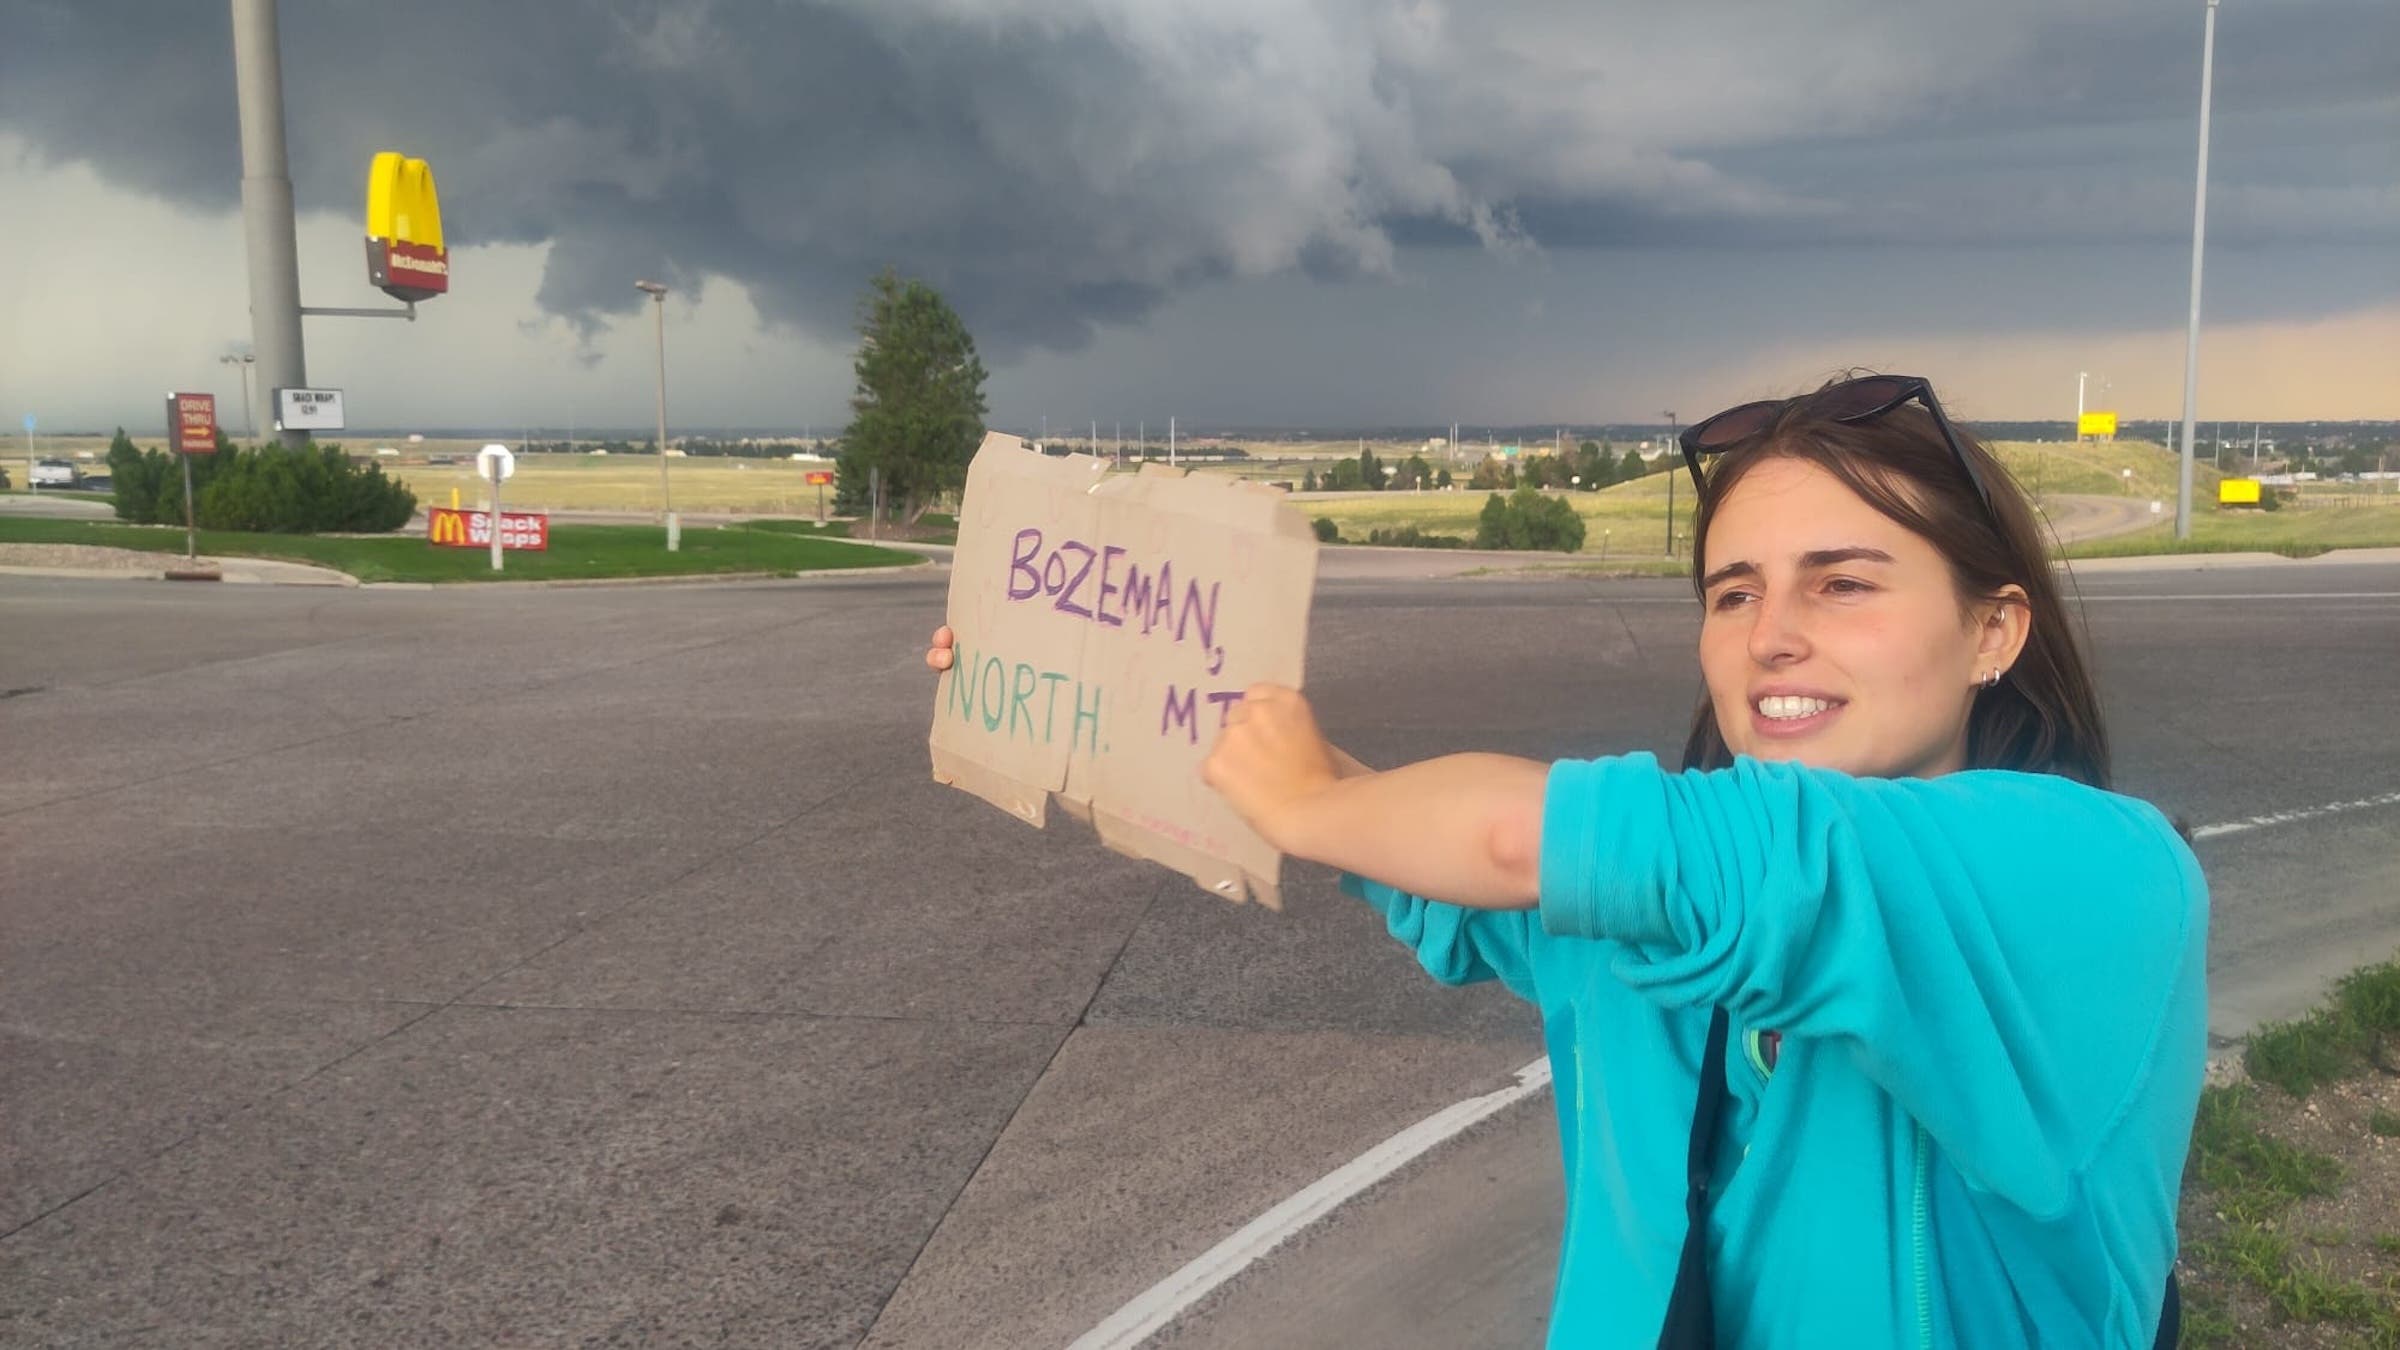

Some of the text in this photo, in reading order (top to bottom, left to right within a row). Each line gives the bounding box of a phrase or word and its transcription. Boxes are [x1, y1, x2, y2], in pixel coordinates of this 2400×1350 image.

[181, 400, 211, 412] DRIVE
[183, 412, 211, 425] THRU
[470, 529, 541, 548] Waps
[1008, 528, 1224, 675] BOZEMAN,
[1161, 685, 1246, 744] MT
